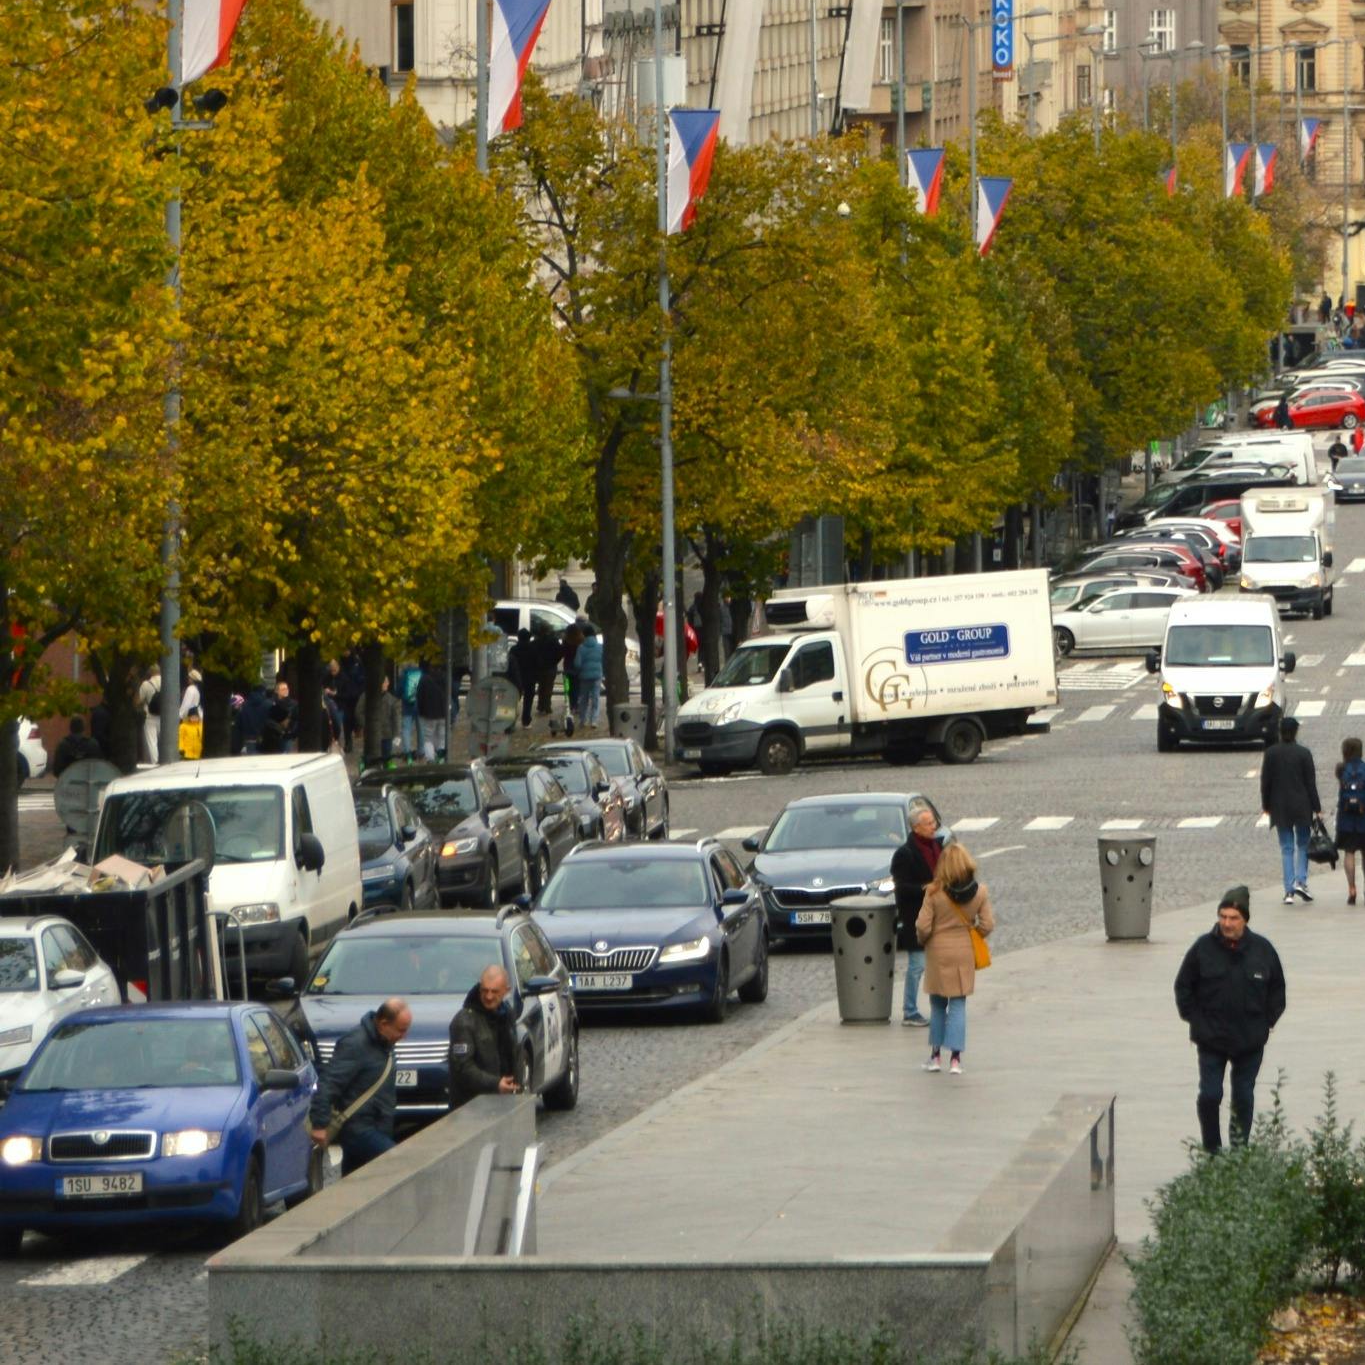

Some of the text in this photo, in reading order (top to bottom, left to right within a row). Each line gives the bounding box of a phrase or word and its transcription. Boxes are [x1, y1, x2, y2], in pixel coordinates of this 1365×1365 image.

[920, 631, 949, 644] GOLD
[957, 627, 992, 641] GROUP
[579, 977, 596, 987] 1AA
[67, 1176, 136, 1192] 1SU 9482
